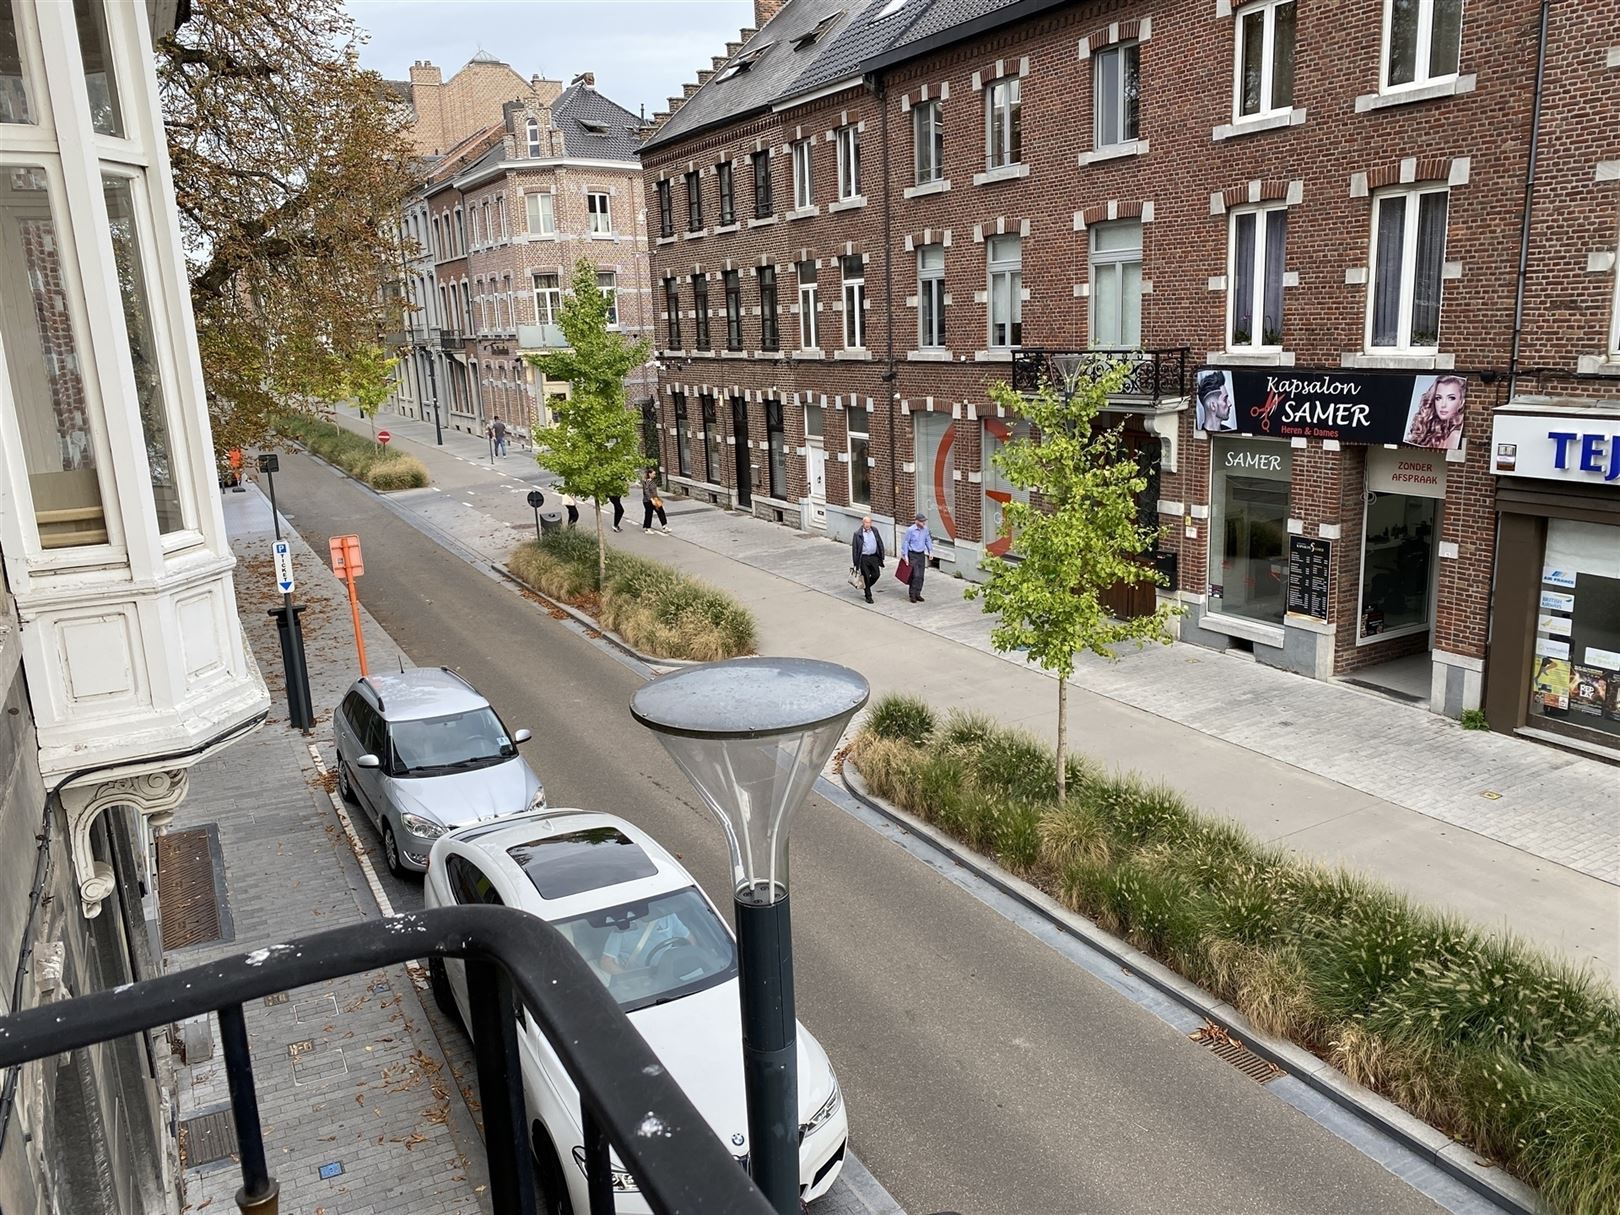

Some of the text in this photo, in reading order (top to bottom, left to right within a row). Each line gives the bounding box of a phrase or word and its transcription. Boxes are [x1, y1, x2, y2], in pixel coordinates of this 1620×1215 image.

[1267, 376, 1361, 398] Kapsalon
[1281, 401, 1371, 427] SAMER
[1281, 425, 1339, 438] Heren & Dames
[1225, 451, 1282, 471] SAMER
[1398, 461, 1433, 472] ZONDER
[1391, 473, 1438, 485] AFSPRAAK
